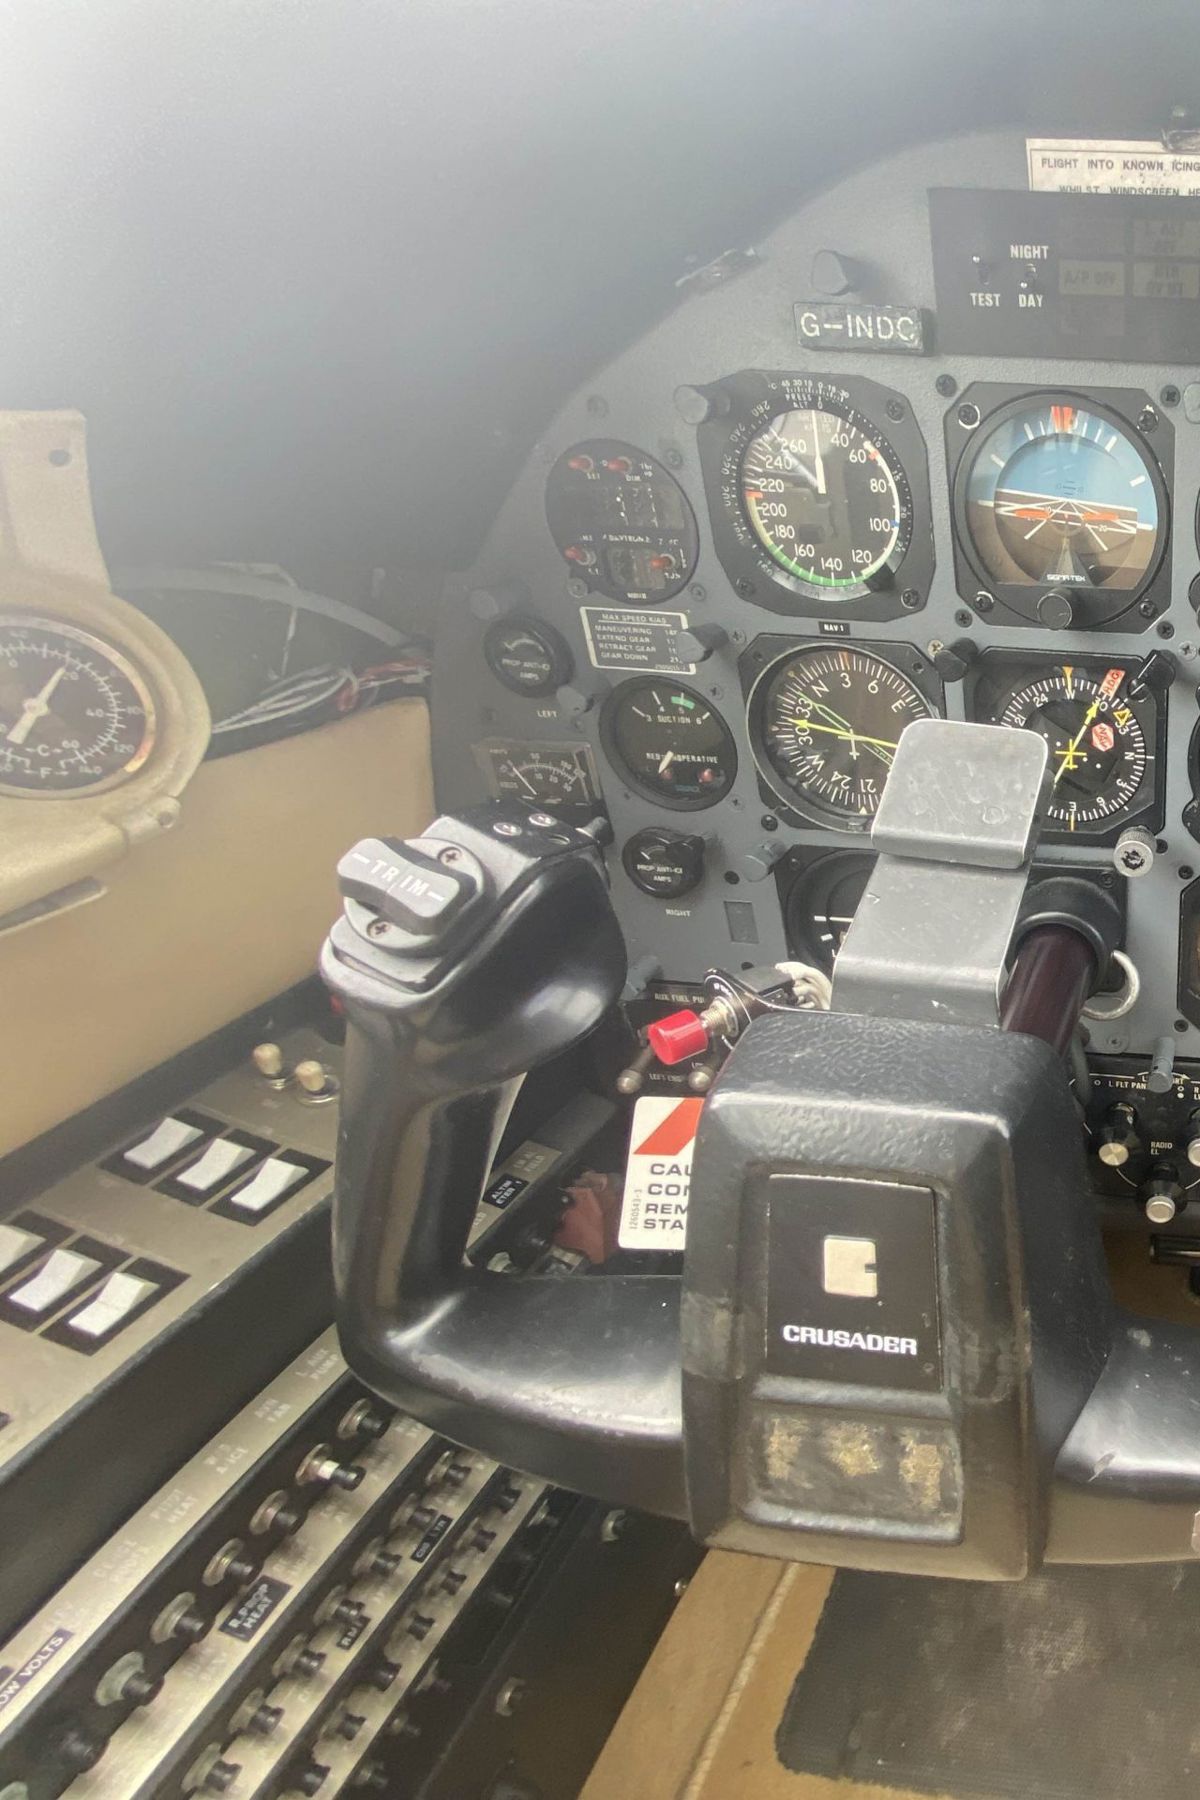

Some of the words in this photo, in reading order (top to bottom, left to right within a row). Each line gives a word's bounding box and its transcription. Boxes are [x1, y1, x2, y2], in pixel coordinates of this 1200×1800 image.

[1041, 158, 1079, 169] FLIGHT
[1088, 159, 1114, 170] INTO
[1123, 160, 1164, 171] KNOWN
[1059, 185, 1100, 194] WHILST
[1110, 186, 1180, 196] WINDSCREEN
[1010, 245, 1049, 260] NIGHT
[970, 293, 1000, 308] TEST
[1018, 294, 1043, 309] DAY
[800, 312, 916, 341] G-INDC
[831, 432, 849, 447] 40
[849, 449, 867, 463] 60
[870, 479, 885, 492] 80
[762, 503, 787, 517] 200
[775, 525, 795, 538] 180
[870, 518, 891, 532] 100
[795, 544, 815, 558] 160
[852, 549, 872, 563] 120
[821, 557, 843, 572] 140
[658, 715, 691, 724] SUCTION
[371, 860, 430, 897] TRIM
[665, 909, 691, 917] RIGHT
[643, 1218, 684, 1231] STA
[782, 1324, 918, 1356] CRUSADER
